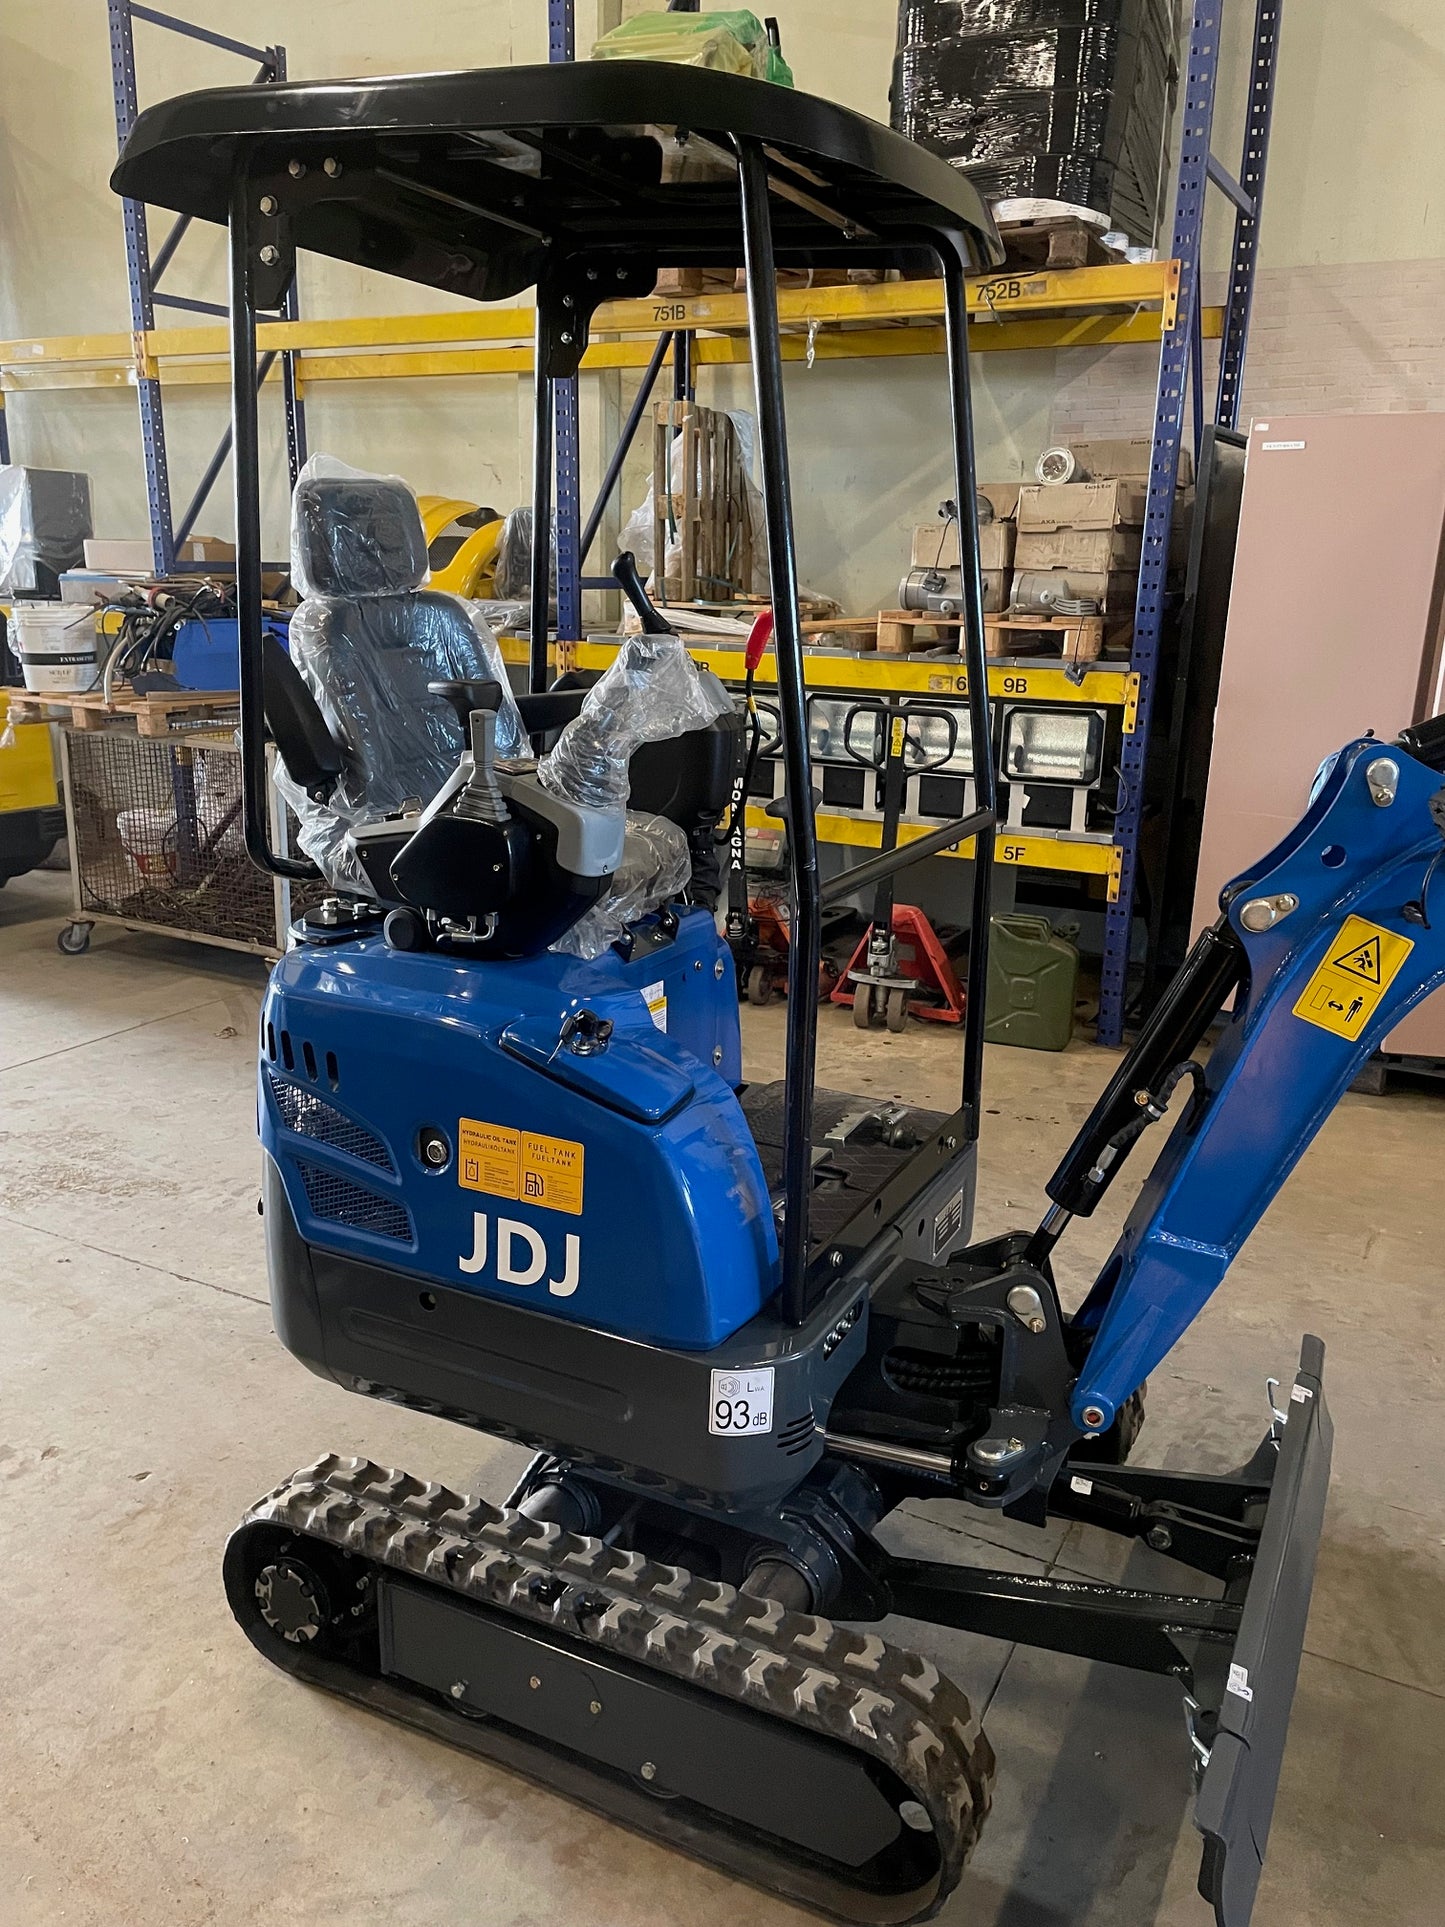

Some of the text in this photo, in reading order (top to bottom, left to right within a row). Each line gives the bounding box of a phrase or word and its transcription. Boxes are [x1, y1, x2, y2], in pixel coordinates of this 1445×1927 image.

[976, 281, 1020, 301] 752B
[652, 304, 685, 321] 751B
[731, 777, 744, 870] MONAGNA
[462, 1129, 517, 1146] HYDRAULIC OIL TANK
[528, 1142, 576, 1159] FUEL TANK
[532, 1152, 571, 1167] FUELTANK
[459, 1211, 580, 1297] JDJ
[715, 1400, 767, 1429] 93 dB
